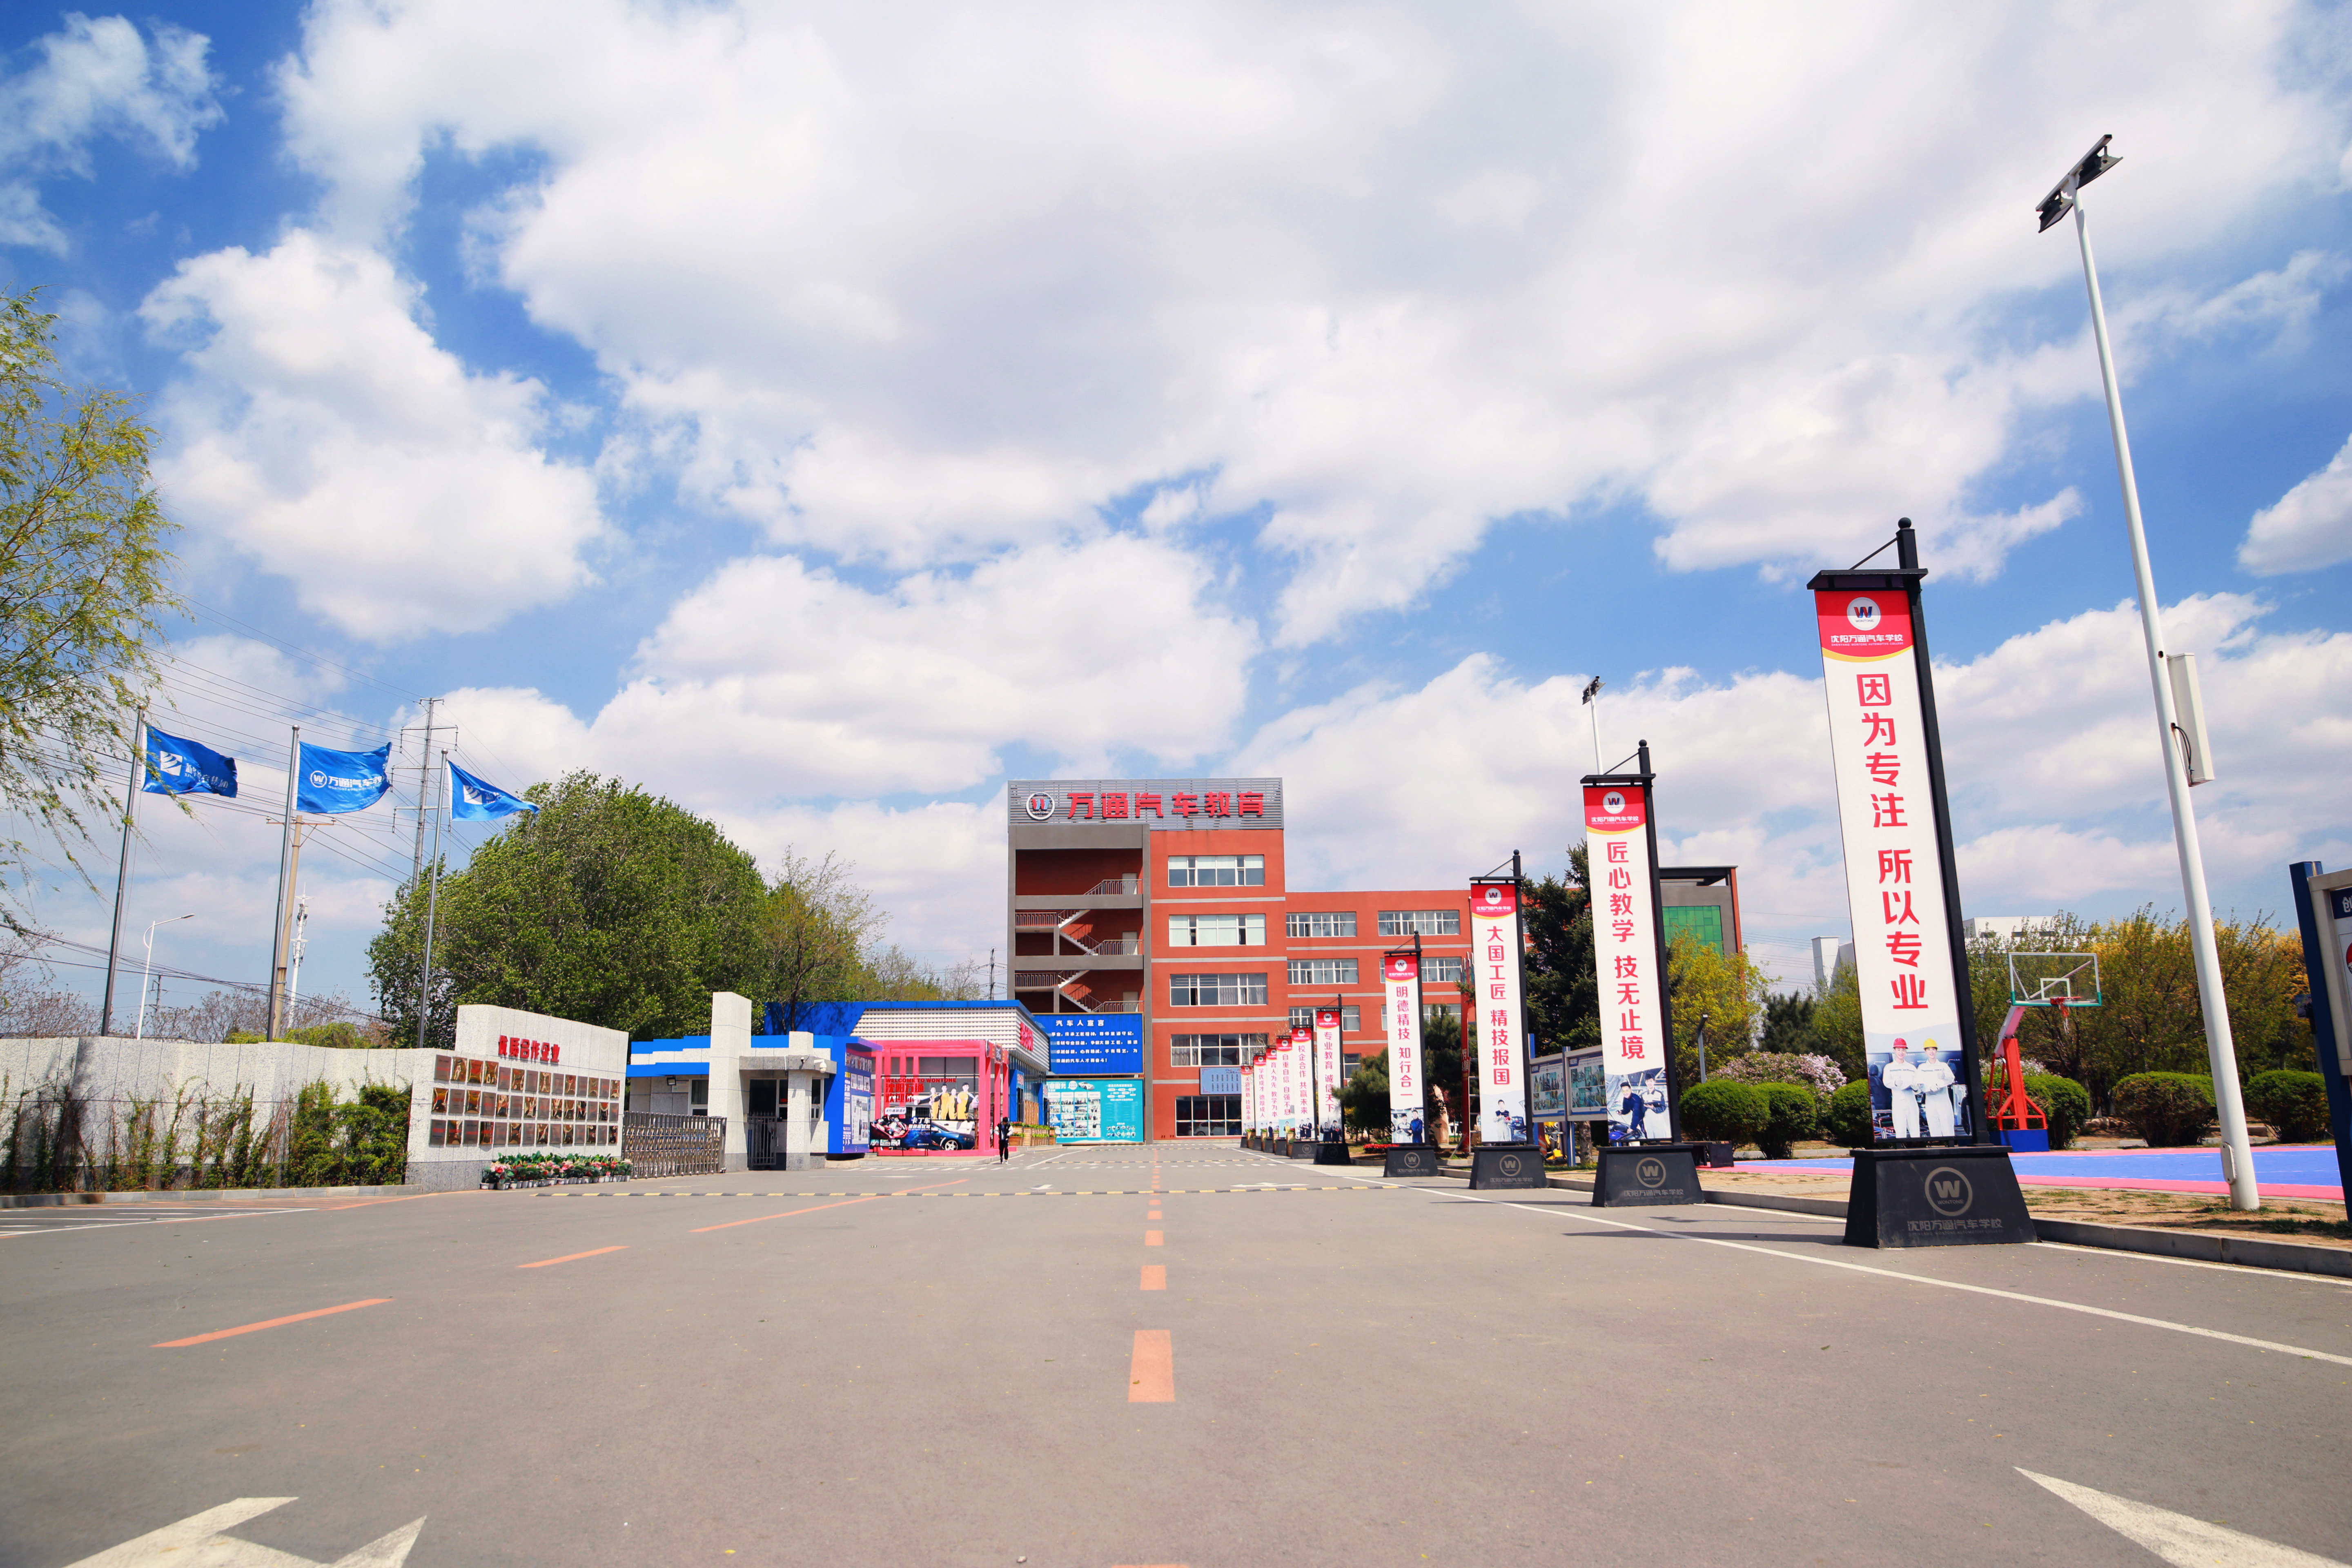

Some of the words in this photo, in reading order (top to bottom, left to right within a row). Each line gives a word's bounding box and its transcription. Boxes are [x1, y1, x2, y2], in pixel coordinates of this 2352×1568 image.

[1831, 634, 1903, 643] 沈阳万通汽车学校
[1856, 674, 1908, 828] 因为专注
[1067, 791, 1264, 819] 万通汽车教育
[1607, 842, 1635, 942] 匠心教学
[1878, 849, 1929, 1009] 所以专业
[1487, 926, 1507, 1000] 大国工匠
[1396, 986, 1410, 1040] 明德精技
[1614, 955, 1645, 1060] 技无止境
[498, 1035, 560, 1062] 优质合作企业
[1298, 1045, 1306, 1078] 校企合作
[1324, 1032, 1333, 1069] 专业教育
[1490, 1009, 1510, 1085] 精技报国
[886, 1083, 924, 1093] 沈阳万通
[1399, 1047, 1413, 1096] 知行合一
[886, 1093, 914, 1102] 欢迎你
[1300, 1082, 1308, 1114] 共赢未来
[1325, 1074, 1334, 1112] 诚信天下
[1624, 1189, 1684, 1197] 沈阳万通汽车学校
[1907, 1218, 2003, 1231] 沈阳万通汽车学校
